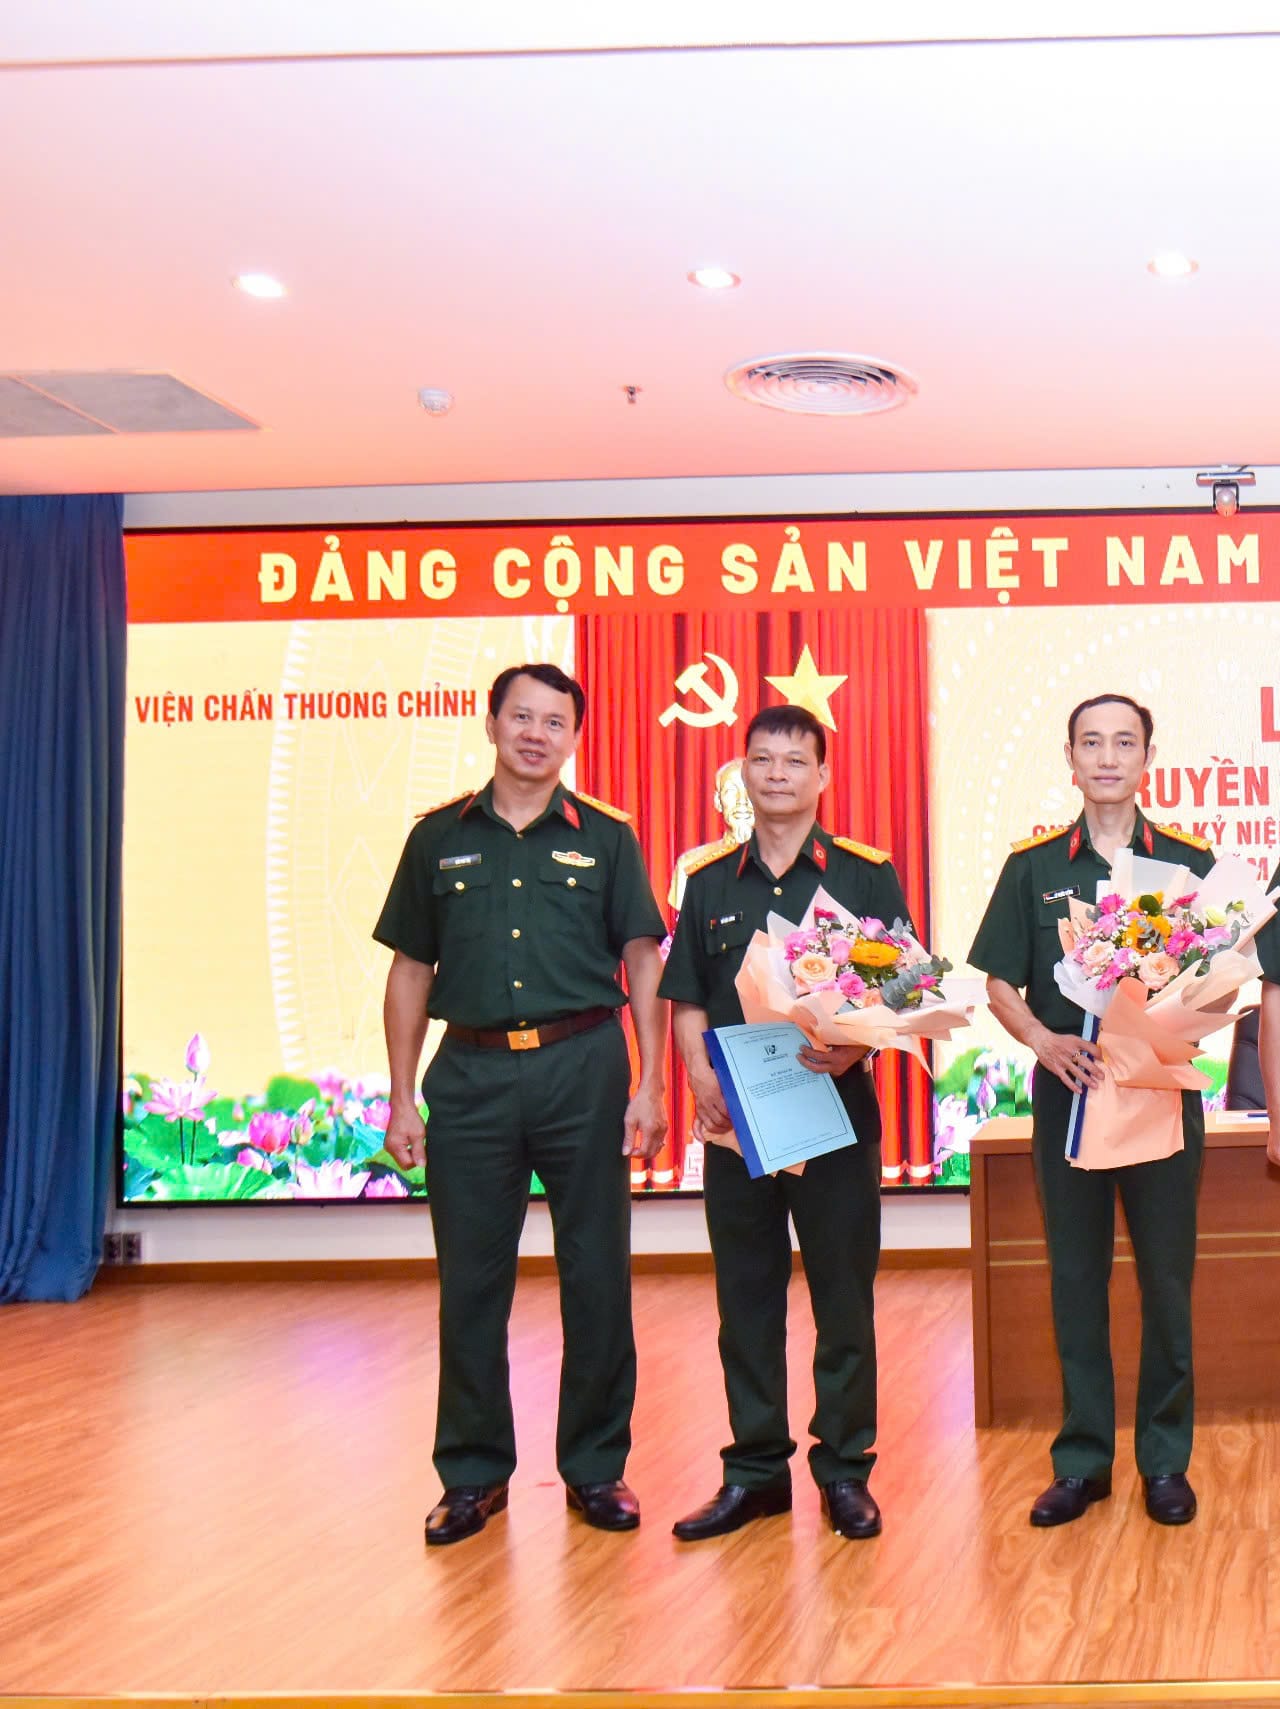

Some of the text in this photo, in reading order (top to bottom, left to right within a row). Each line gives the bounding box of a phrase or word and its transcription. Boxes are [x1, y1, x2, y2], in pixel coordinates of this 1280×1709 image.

[259, 535, 457, 603] ĐẢNG
[493, 536, 684, 613] CỘNG
[721, 526, 867, 596] SẢN
[905, 527, 1069, 605] VIỆT
[1106, 533, 1260, 587] NAM
[135, 692, 194, 727] VIỆN
[203, 687, 273, 722] CHẤN
[283, 690, 388, 720] THƯƠNG
[397, 682, 477, 718] CHỈNH
